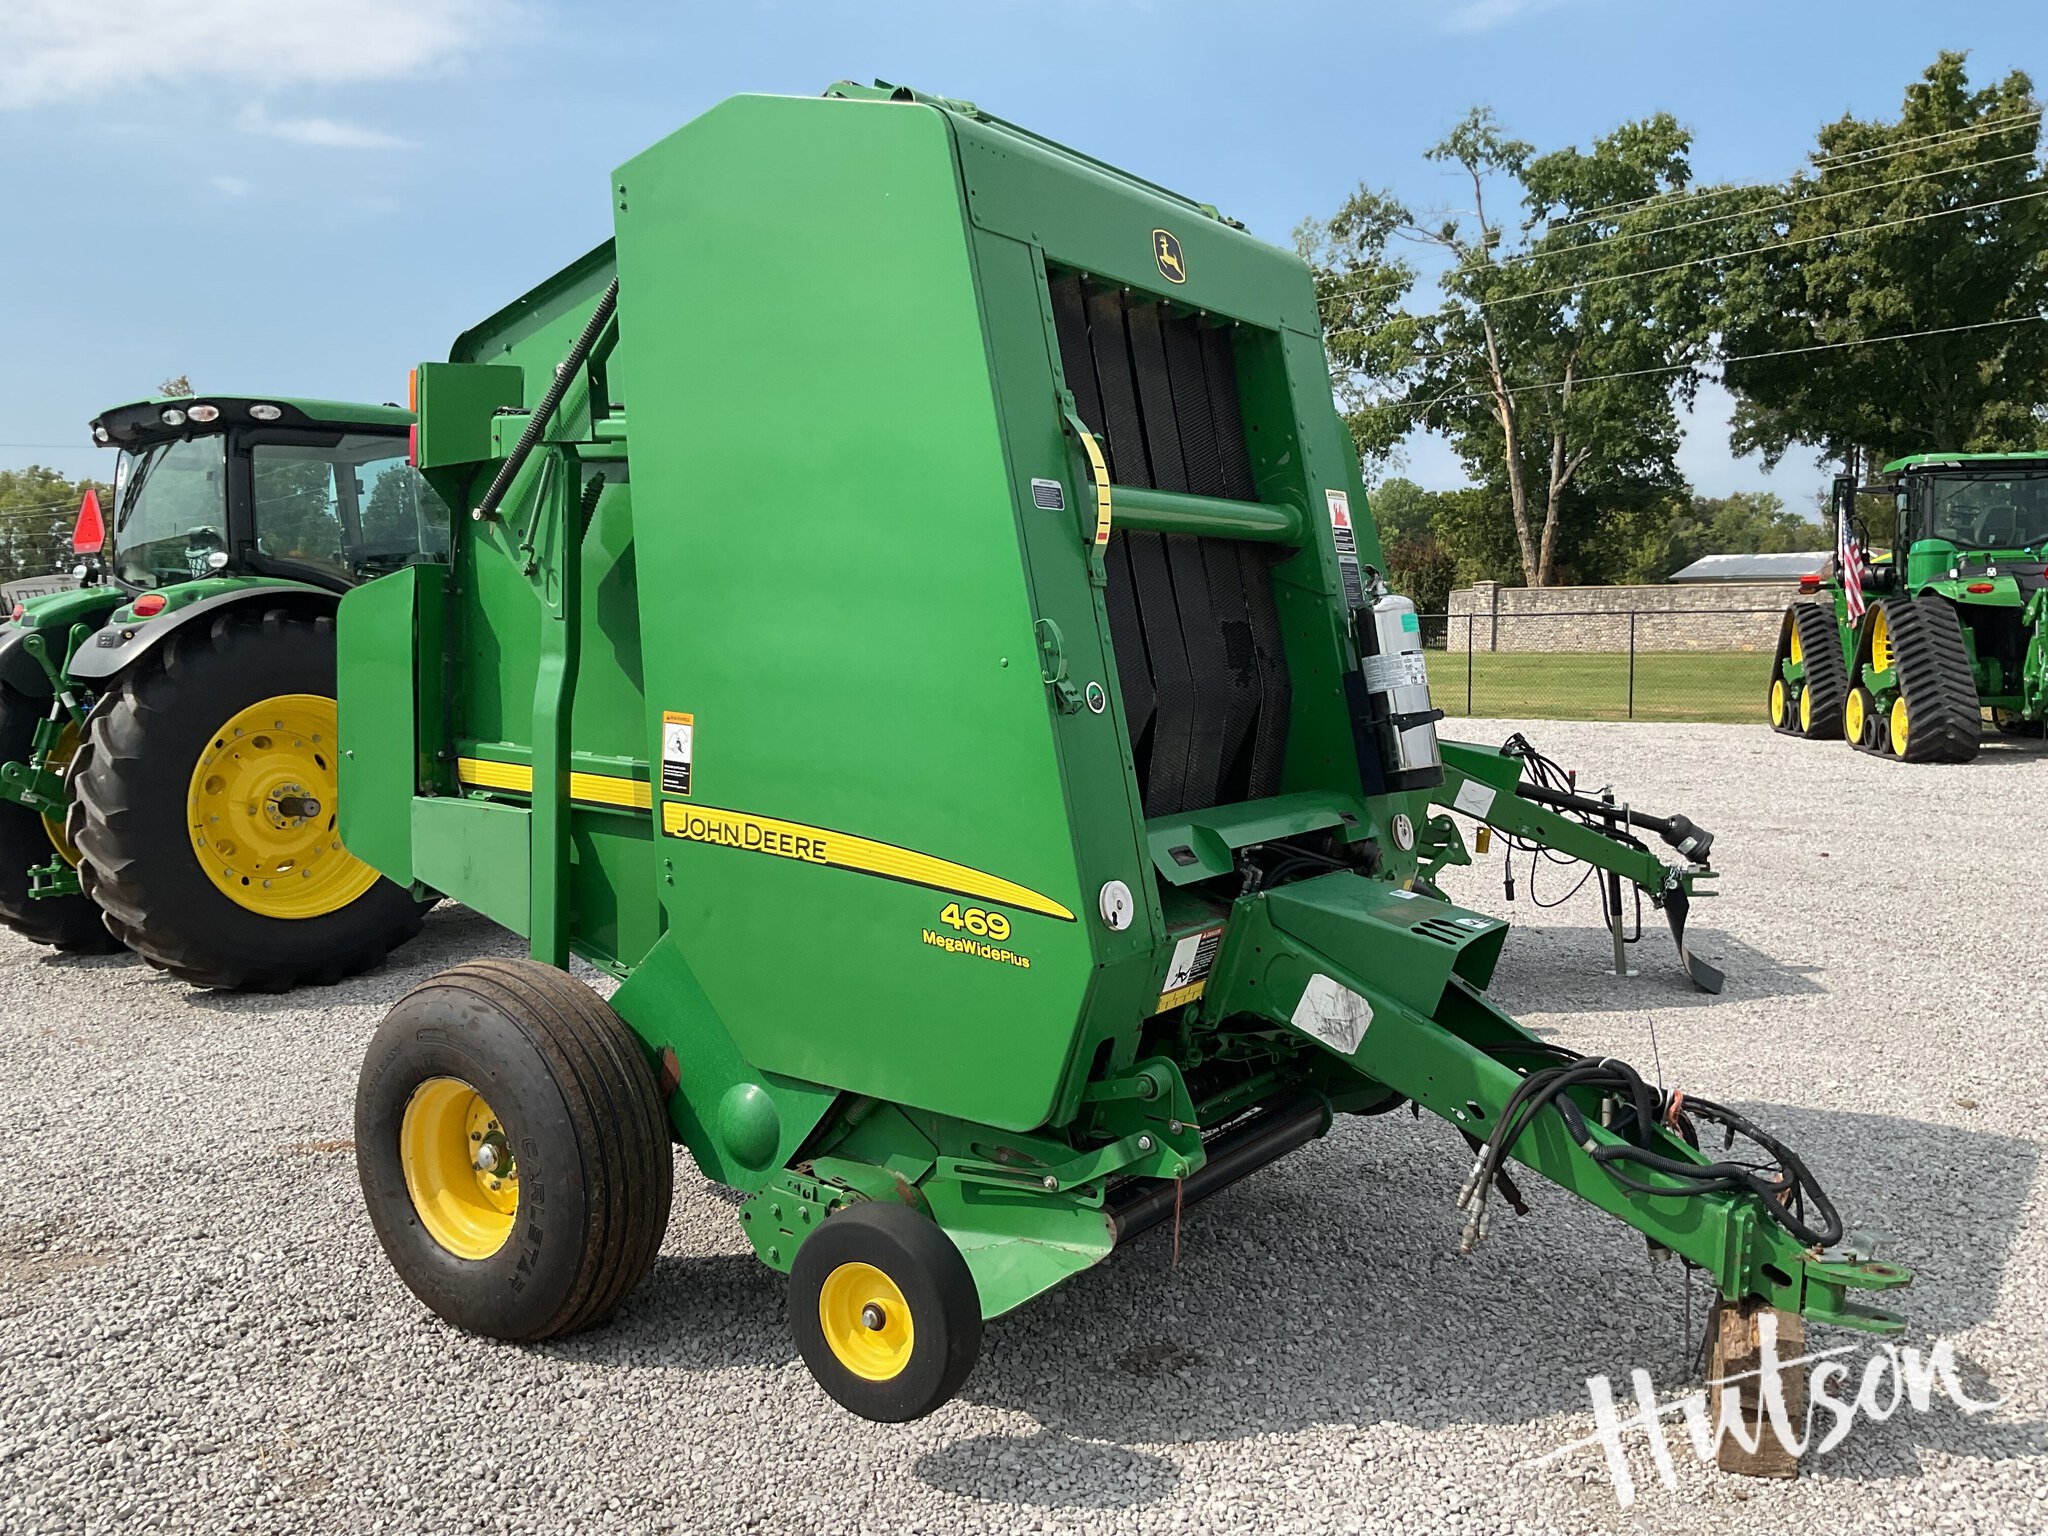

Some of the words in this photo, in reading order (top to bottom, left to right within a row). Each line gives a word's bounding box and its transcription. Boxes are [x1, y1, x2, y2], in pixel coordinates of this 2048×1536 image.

[677, 812, 739, 843] JOHN
[745, 823, 827, 860] DEERE
[939, 902, 1012, 941] 469
[922, 929, 1031, 968] MegaWidePlus
